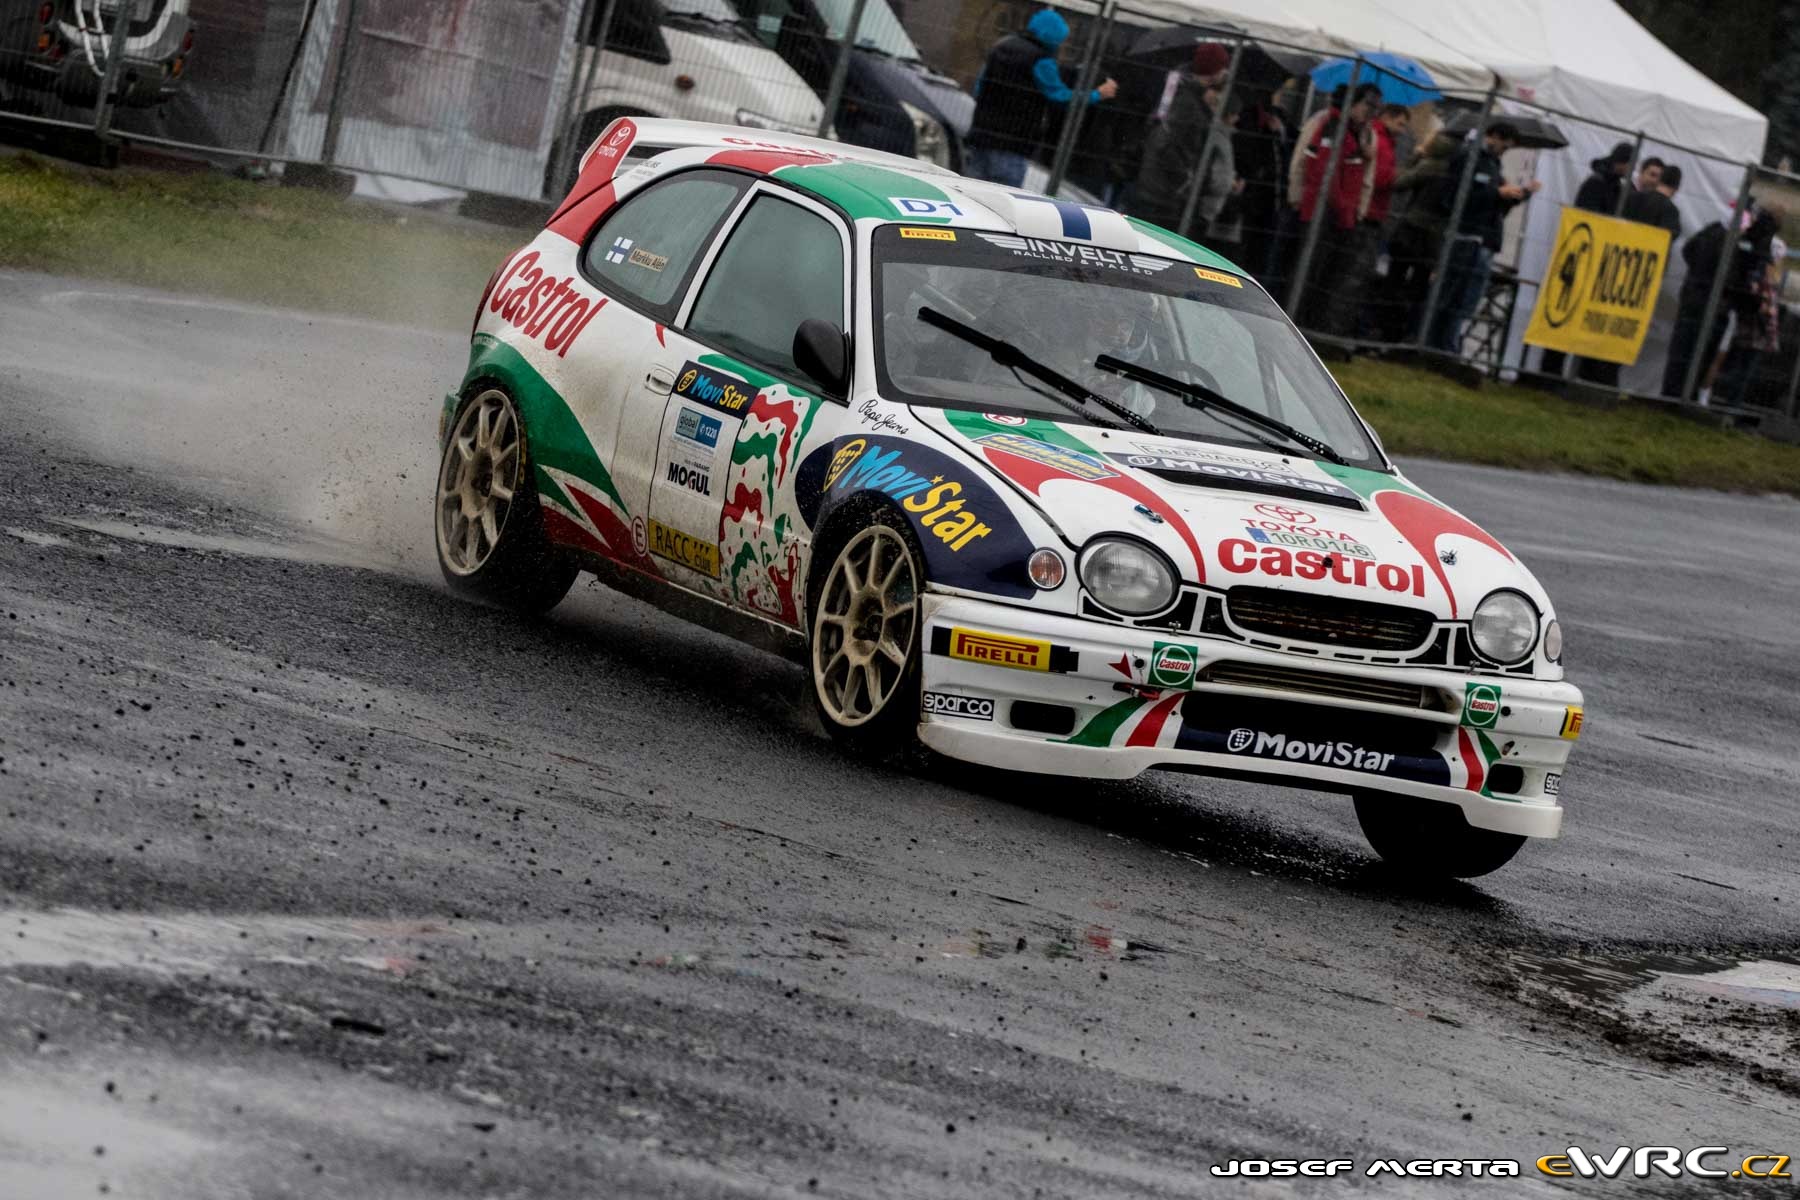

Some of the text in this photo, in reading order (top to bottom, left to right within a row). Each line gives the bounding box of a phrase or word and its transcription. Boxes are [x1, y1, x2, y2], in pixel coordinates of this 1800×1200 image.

[899, 199, 963, 216] D1
[1013, 250, 1073, 262] RALLIED
[1095, 262, 1153, 275] RACED
[1027, 238, 1126, 265] INVELT
[490, 250, 609, 359] Castrol
[690, 374, 749, 411] MoviStar
[858, 399, 910, 435] Pepe Jeans
[667, 461, 710, 497] MOGUL
[1161, 458, 1338, 494] MoviStar
[838, 445, 993, 551] MoviStar
[655, 525, 691, 563] RACC
[1240, 518, 1360, 544] TOYOTA
[1218, 538, 1426, 598] Castrol
[957, 633, 1040, 666] PIRELLI
[1158, 657, 1192, 672] Castrol
[924, 693, 993, 718] sparco
[1471, 699, 1497, 712] Castrol
[1253, 731, 1396, 772] MoviStar
